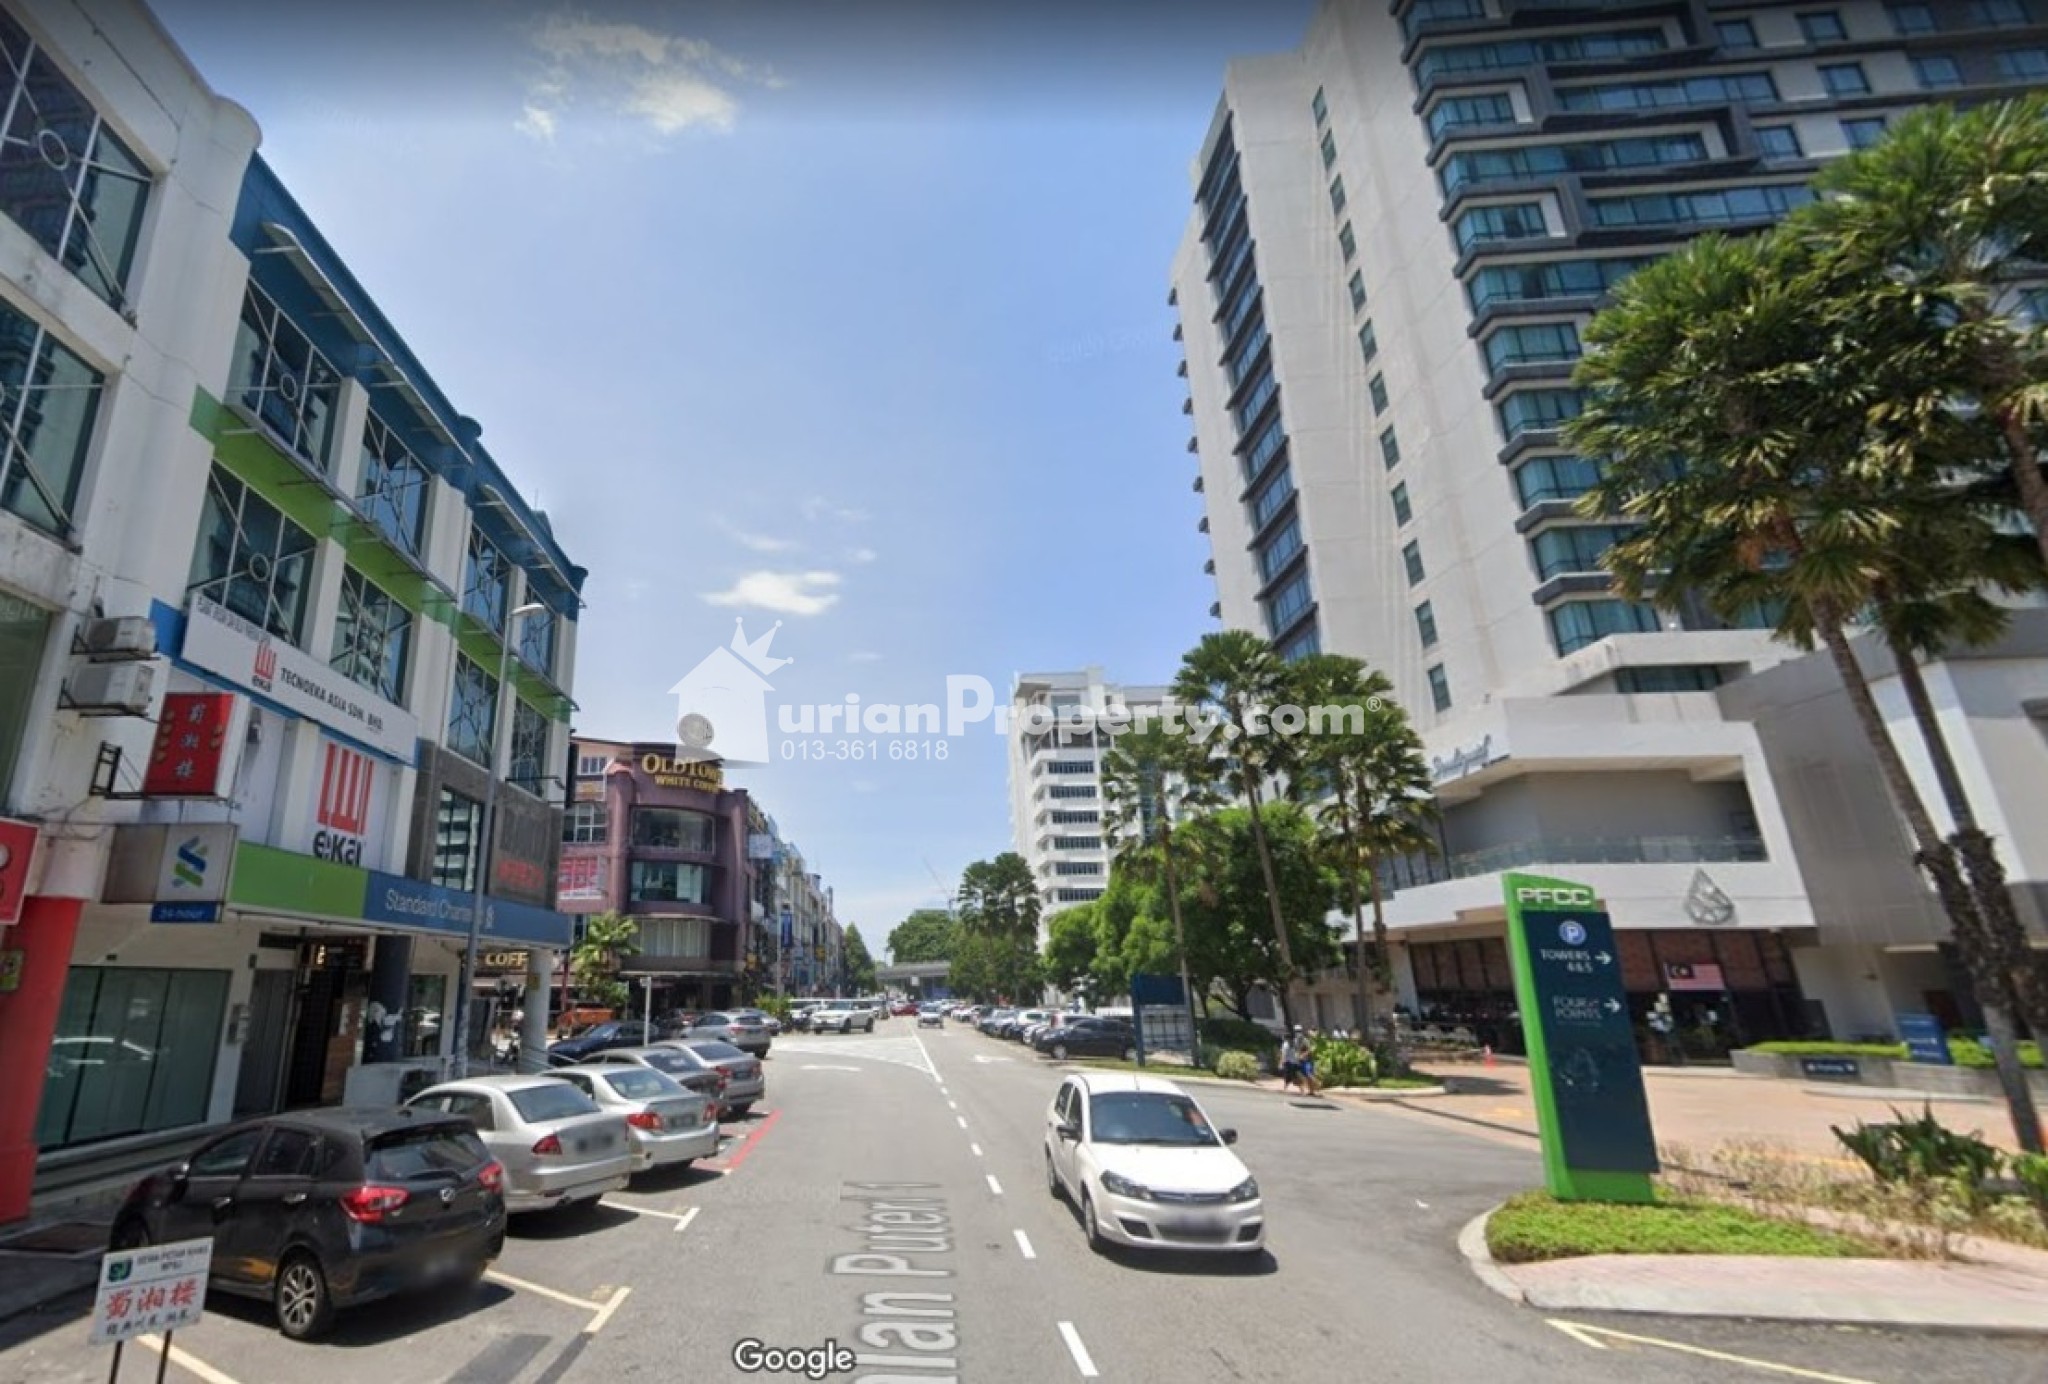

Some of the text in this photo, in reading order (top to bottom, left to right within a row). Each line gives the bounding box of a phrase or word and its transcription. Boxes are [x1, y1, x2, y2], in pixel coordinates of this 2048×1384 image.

[327, 692, 346, 711] ASIA
[385, 887, 437, 917] Standard
[1516, 887, 1592, 906] PFCC
[1540, 949, 1592, 961] TOWERS
